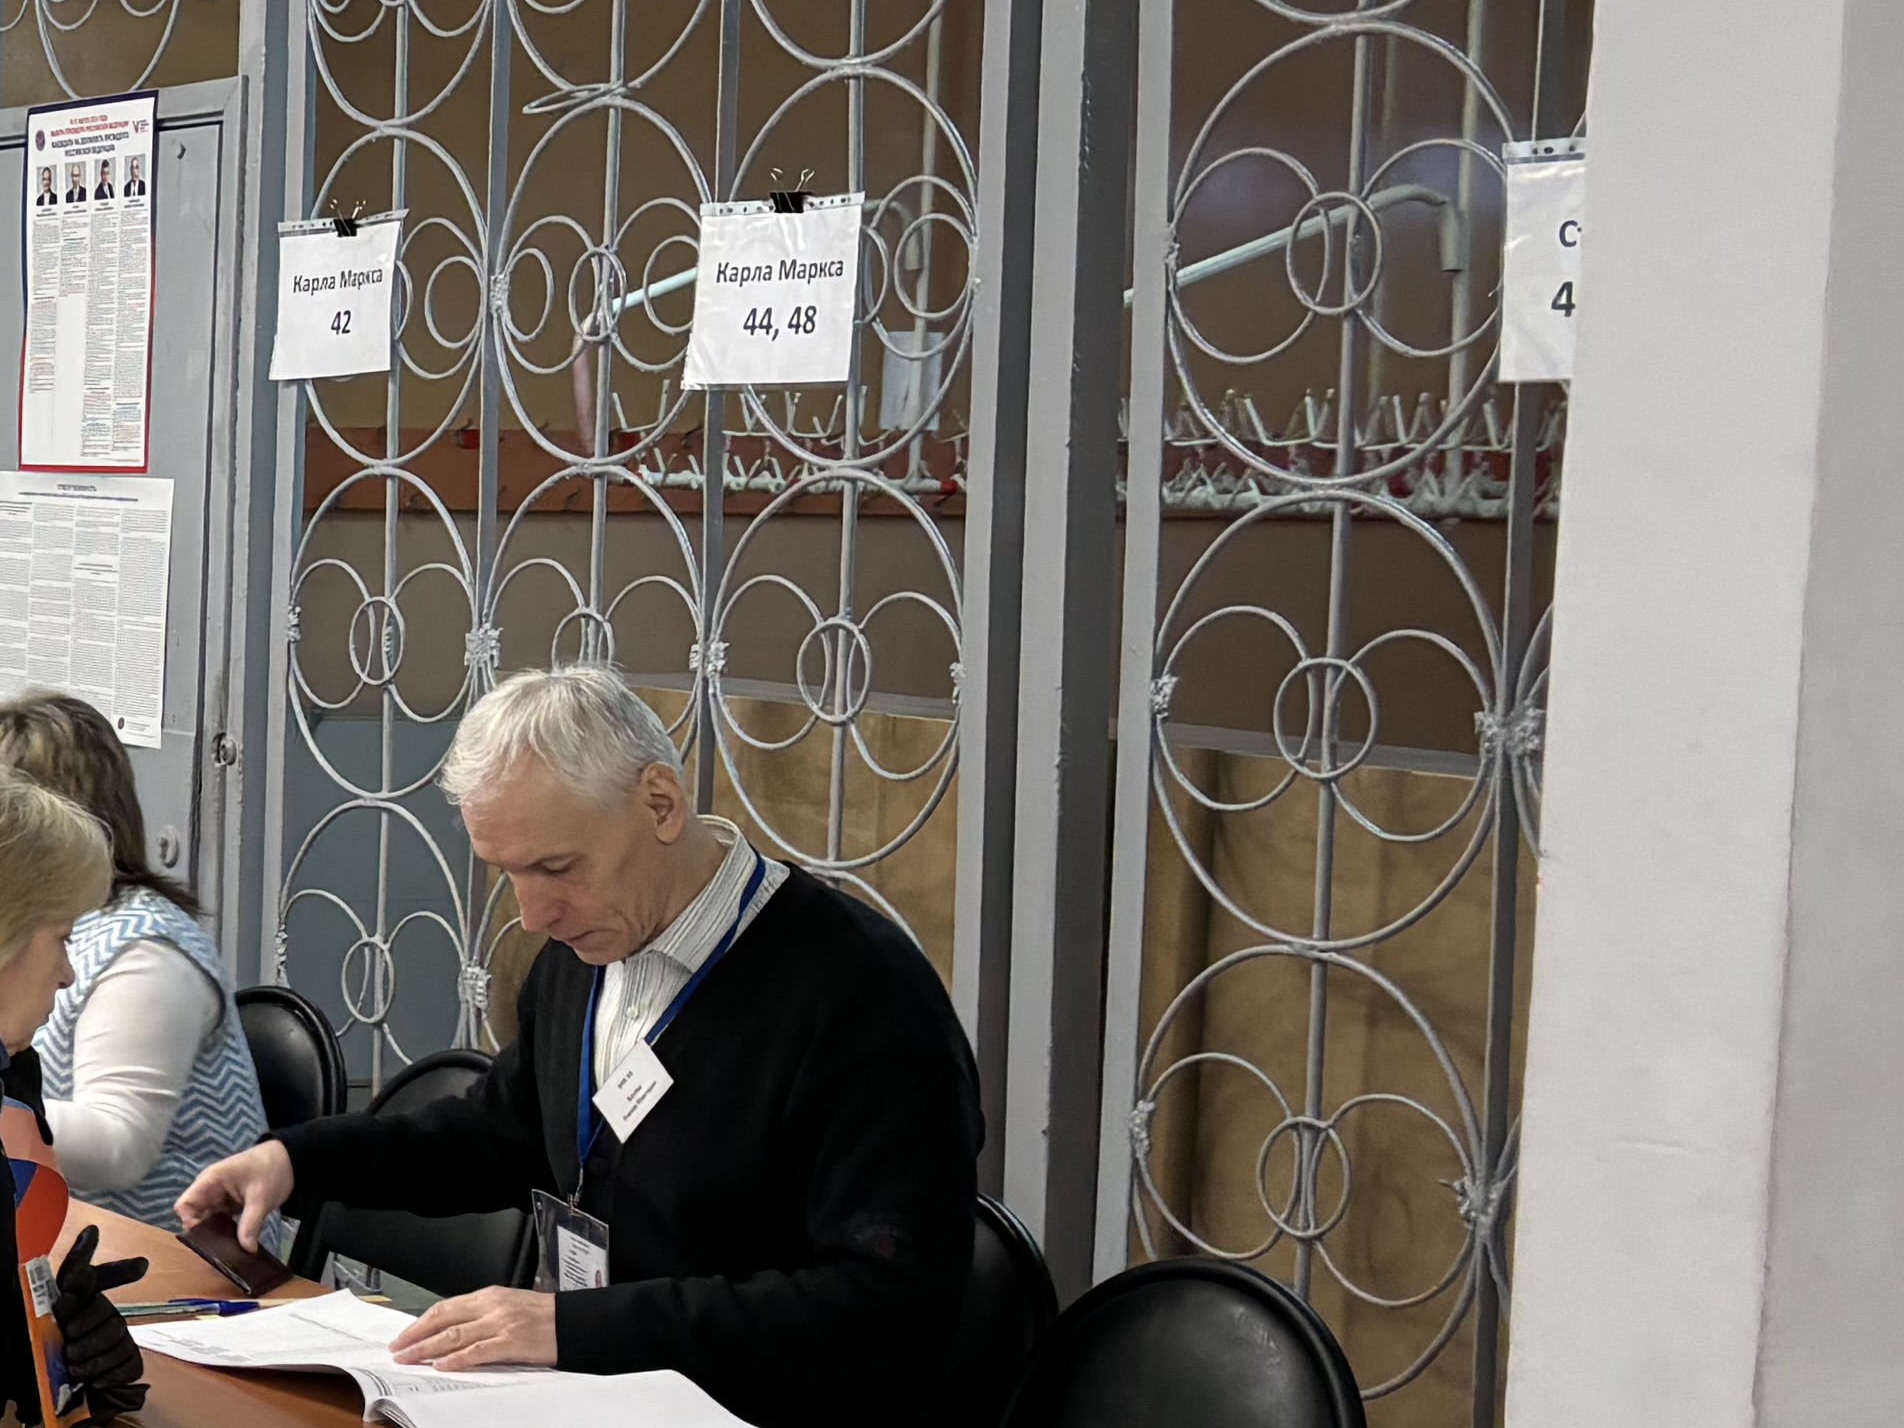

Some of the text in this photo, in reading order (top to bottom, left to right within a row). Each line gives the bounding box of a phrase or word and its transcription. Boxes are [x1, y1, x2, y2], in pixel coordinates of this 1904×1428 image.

[1558, 219, 1583, 248] С
[293, 269, 383, 296] Карла Маркса
[716, 258, 844, 287] Карла Маркса
[330, 310, 352, 335] 42
[743, 305, 817, 342] 44, 48
